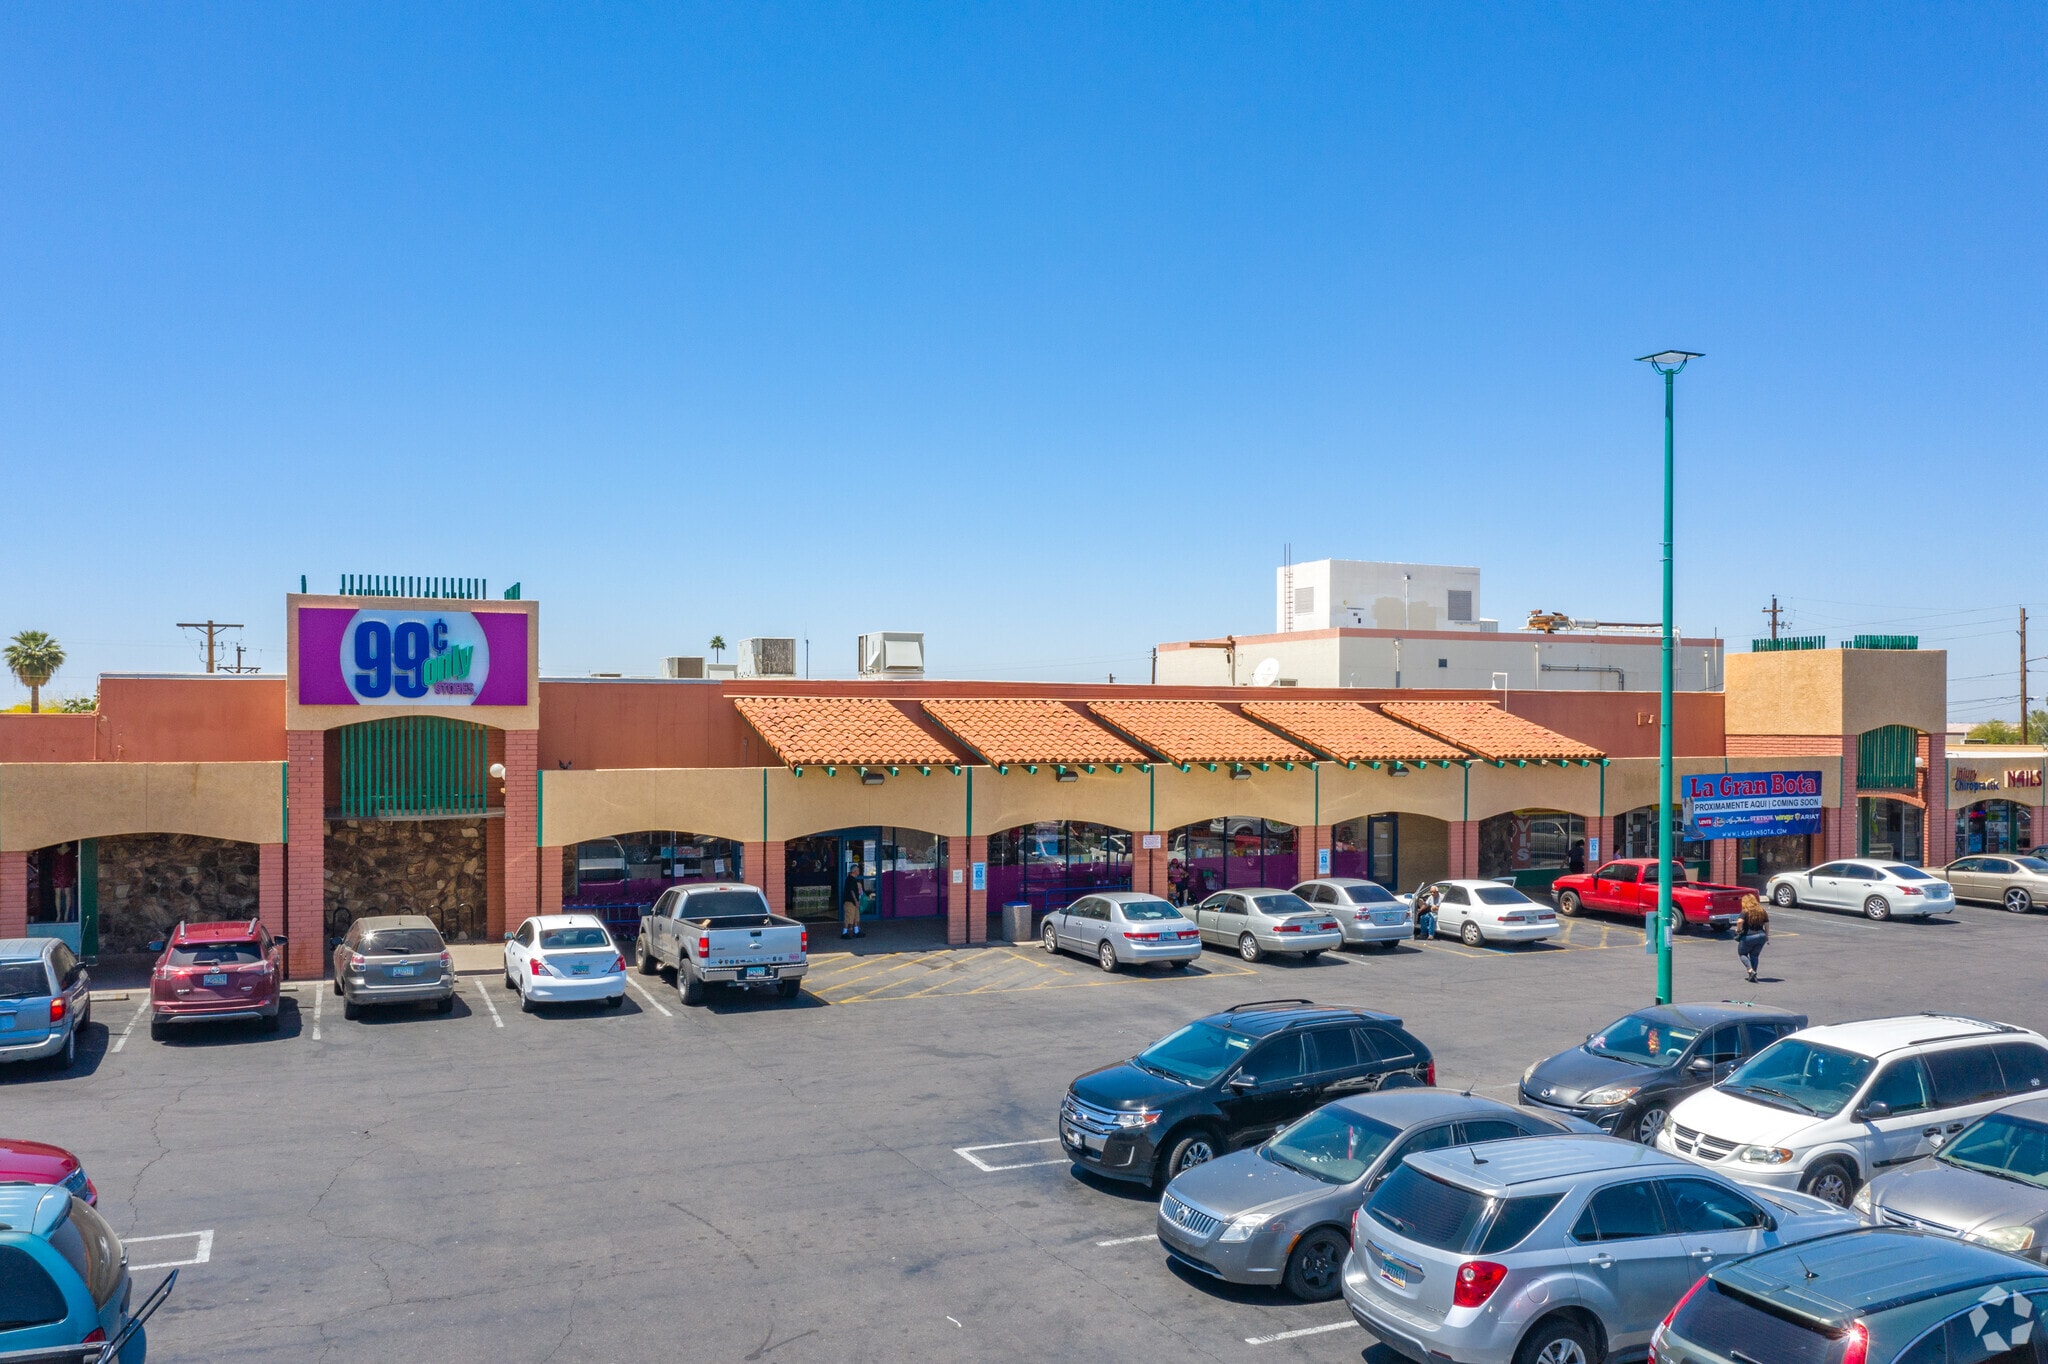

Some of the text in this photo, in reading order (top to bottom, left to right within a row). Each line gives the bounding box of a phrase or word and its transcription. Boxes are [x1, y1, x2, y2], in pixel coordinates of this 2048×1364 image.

[423, 644, 474, 687] only
[434, 682, 474, 695] STORES
[1690, 774, 1816, 798] La Gran Bota
[1954, 780, 2000, 794] Chiropractic
[2006, 770, 2043, 788] NAILS
[1694, 801, 1749, 811] PROXIMAMENTE
[1750, 799, 1768, 809] AQUI
[1771, 798, 1799, 808] COMING
[1800, 798, 1819, 807] SOON
